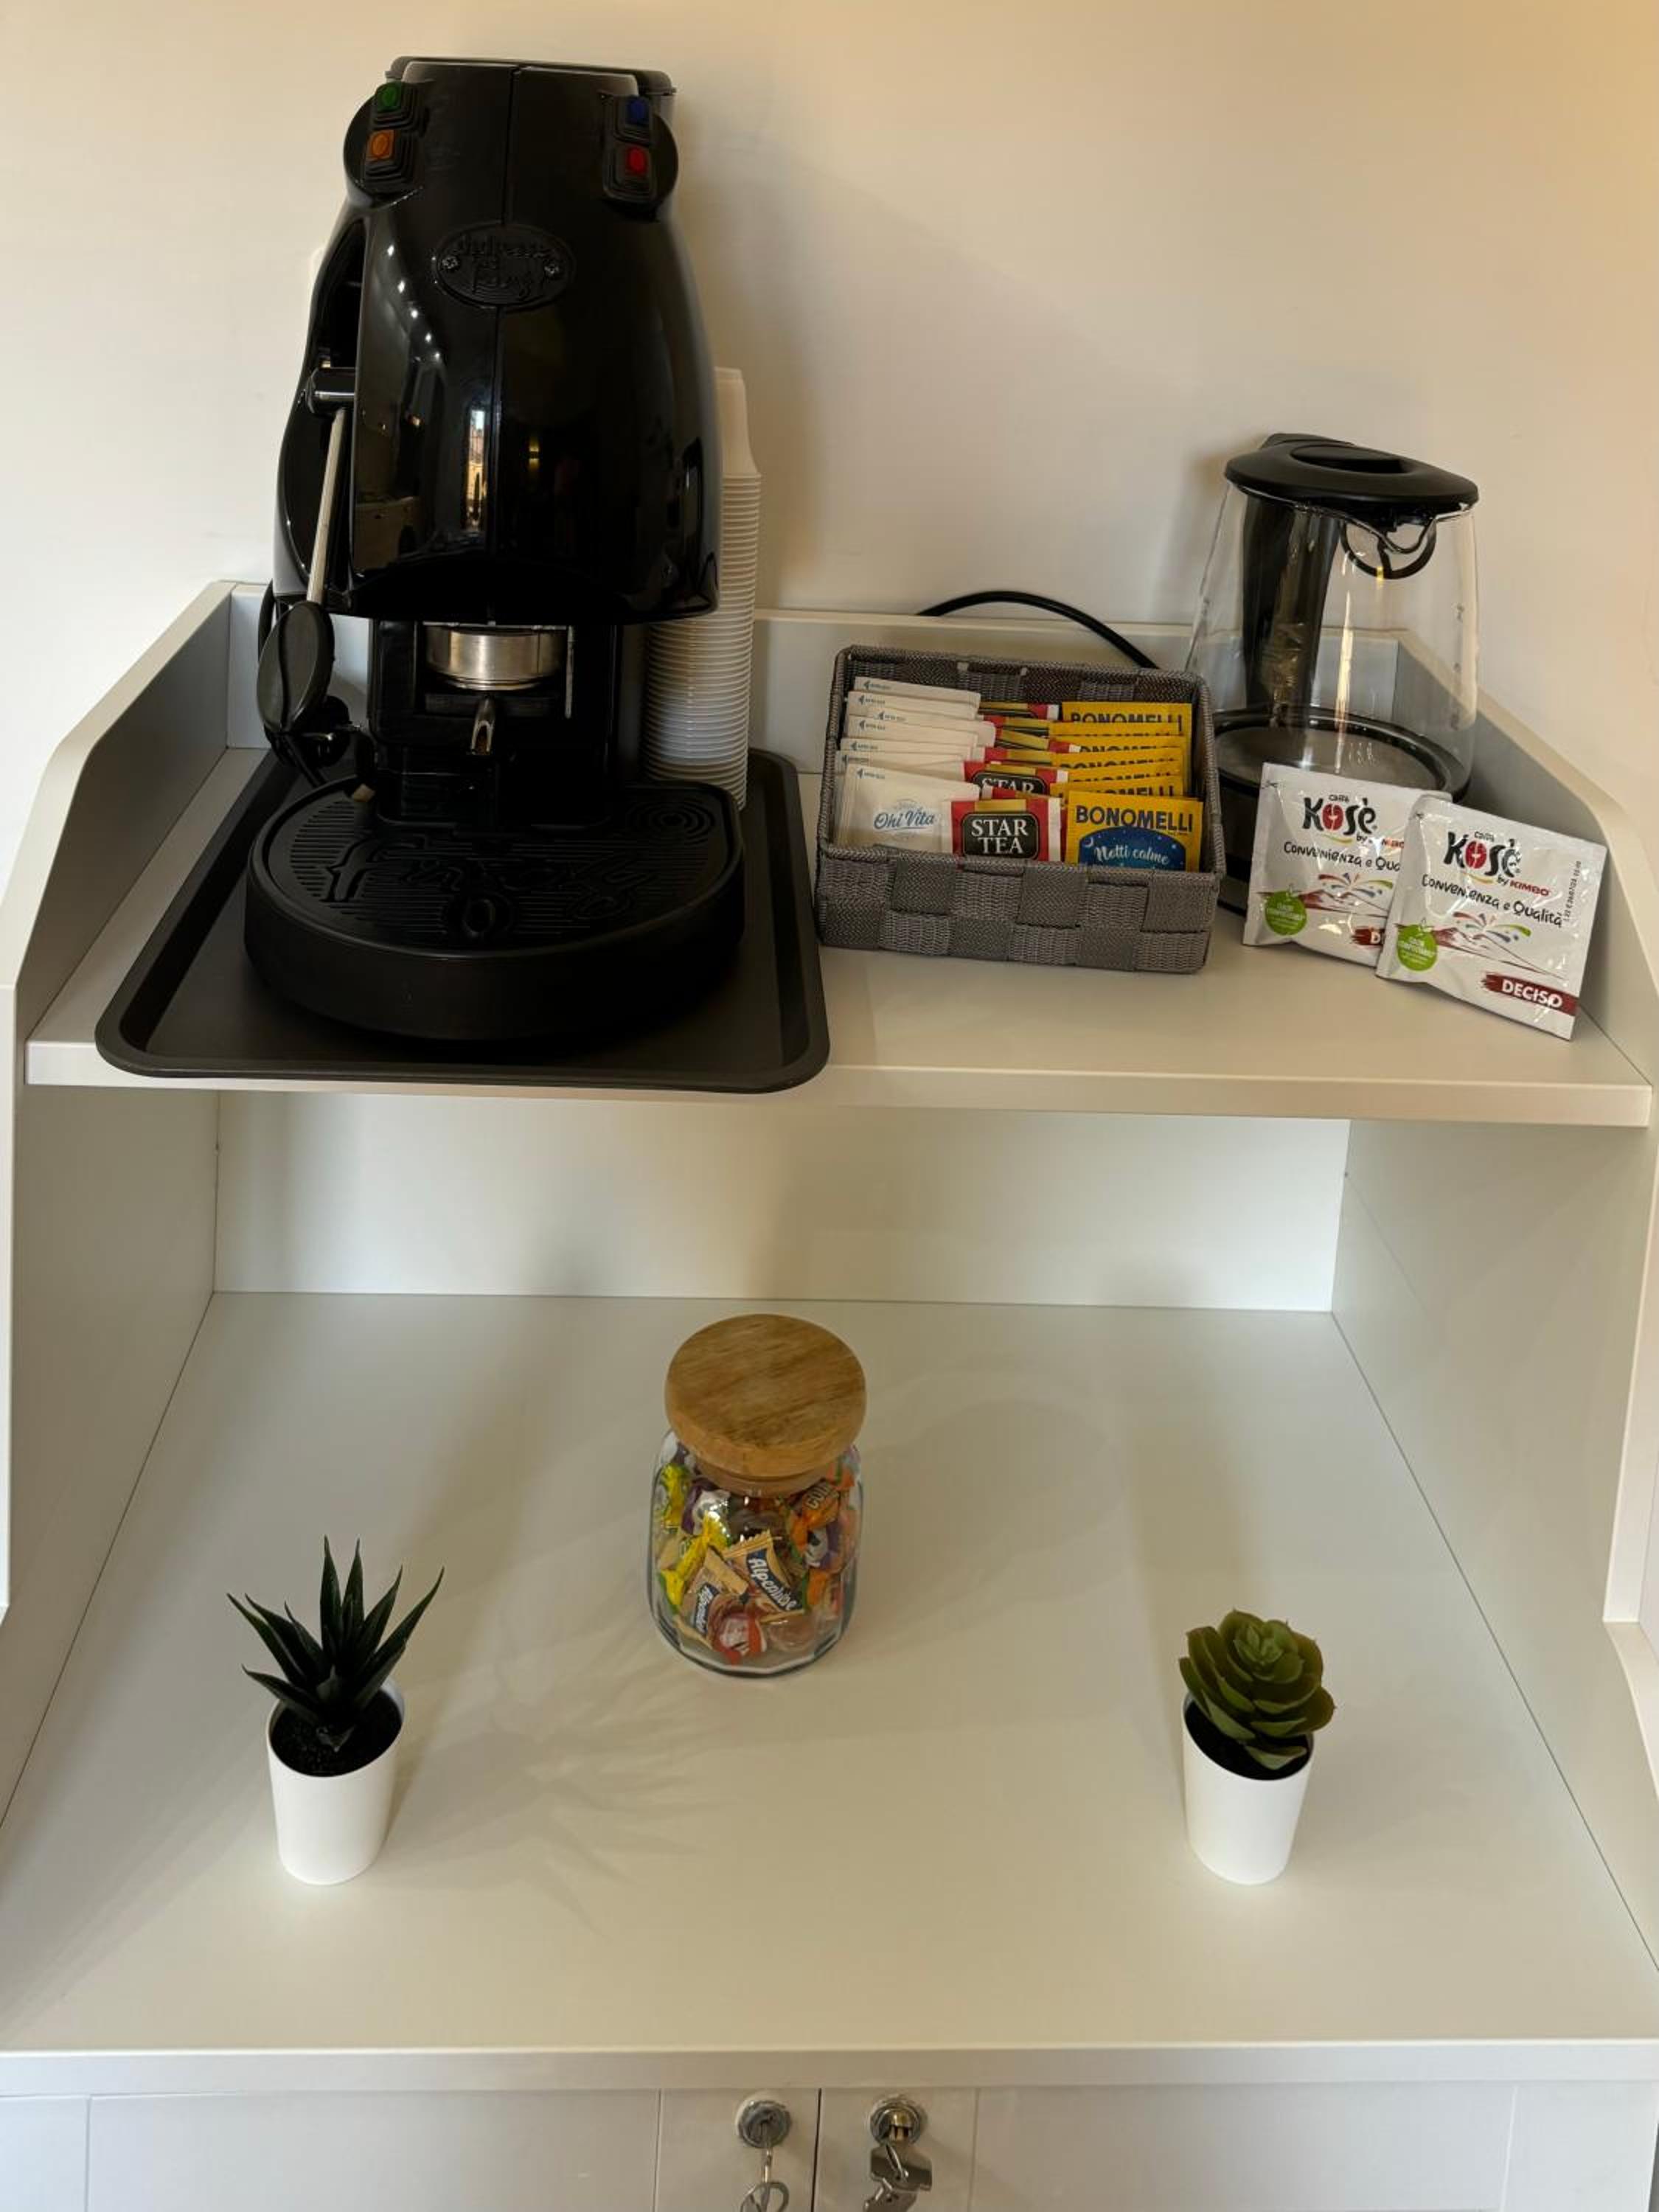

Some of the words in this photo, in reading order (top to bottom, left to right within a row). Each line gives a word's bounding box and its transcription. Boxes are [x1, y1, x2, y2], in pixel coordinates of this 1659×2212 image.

[905, 809, 935, 827] Vita
[971, 818, 1029, 837] STAR
[1076, 804, 1193, 832] BONOMELLI
[977, 837, 1023, 855] TEA
[1356, 832, 1368, 844] by
[1093, 844, 1129, 862] Notti
[1131, 846, 1169, 865] calme
[1365, 859, 1373, 868] e
[1497, 874, 1510, 886] by
[1509, 879, 1551, 897] KIMBO
[1503, 902, 1511, 911] e
[1513, 900, 1562, 928] Qualità
[1501, 978, 1563, 1009] DECISO
